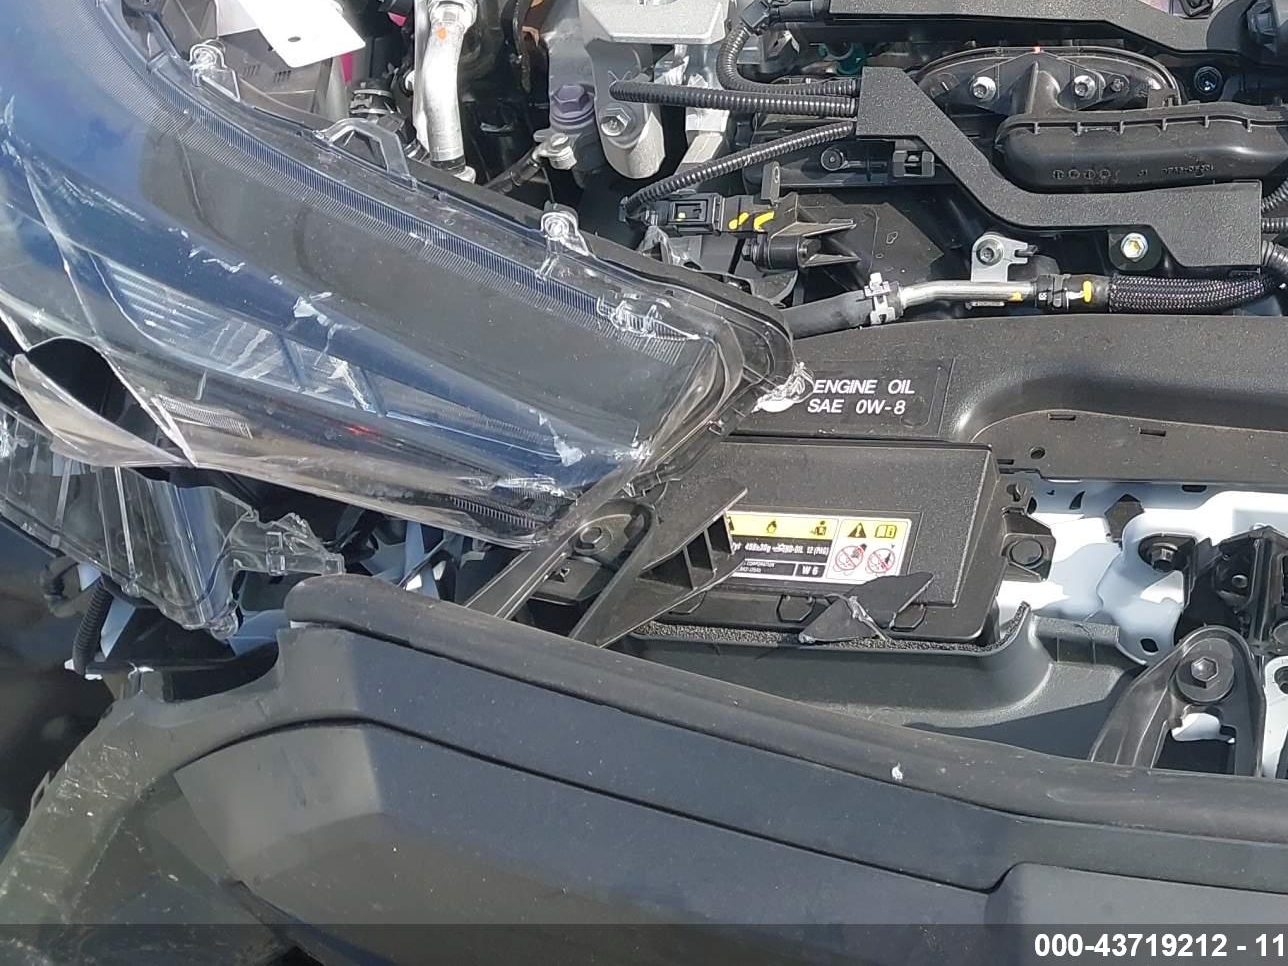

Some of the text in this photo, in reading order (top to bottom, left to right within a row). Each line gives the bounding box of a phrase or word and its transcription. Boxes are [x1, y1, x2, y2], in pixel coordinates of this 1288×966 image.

[813, 379, 915, 394] ENGINE OIL
[807, 398, 906, 415] SAE 0W-8
